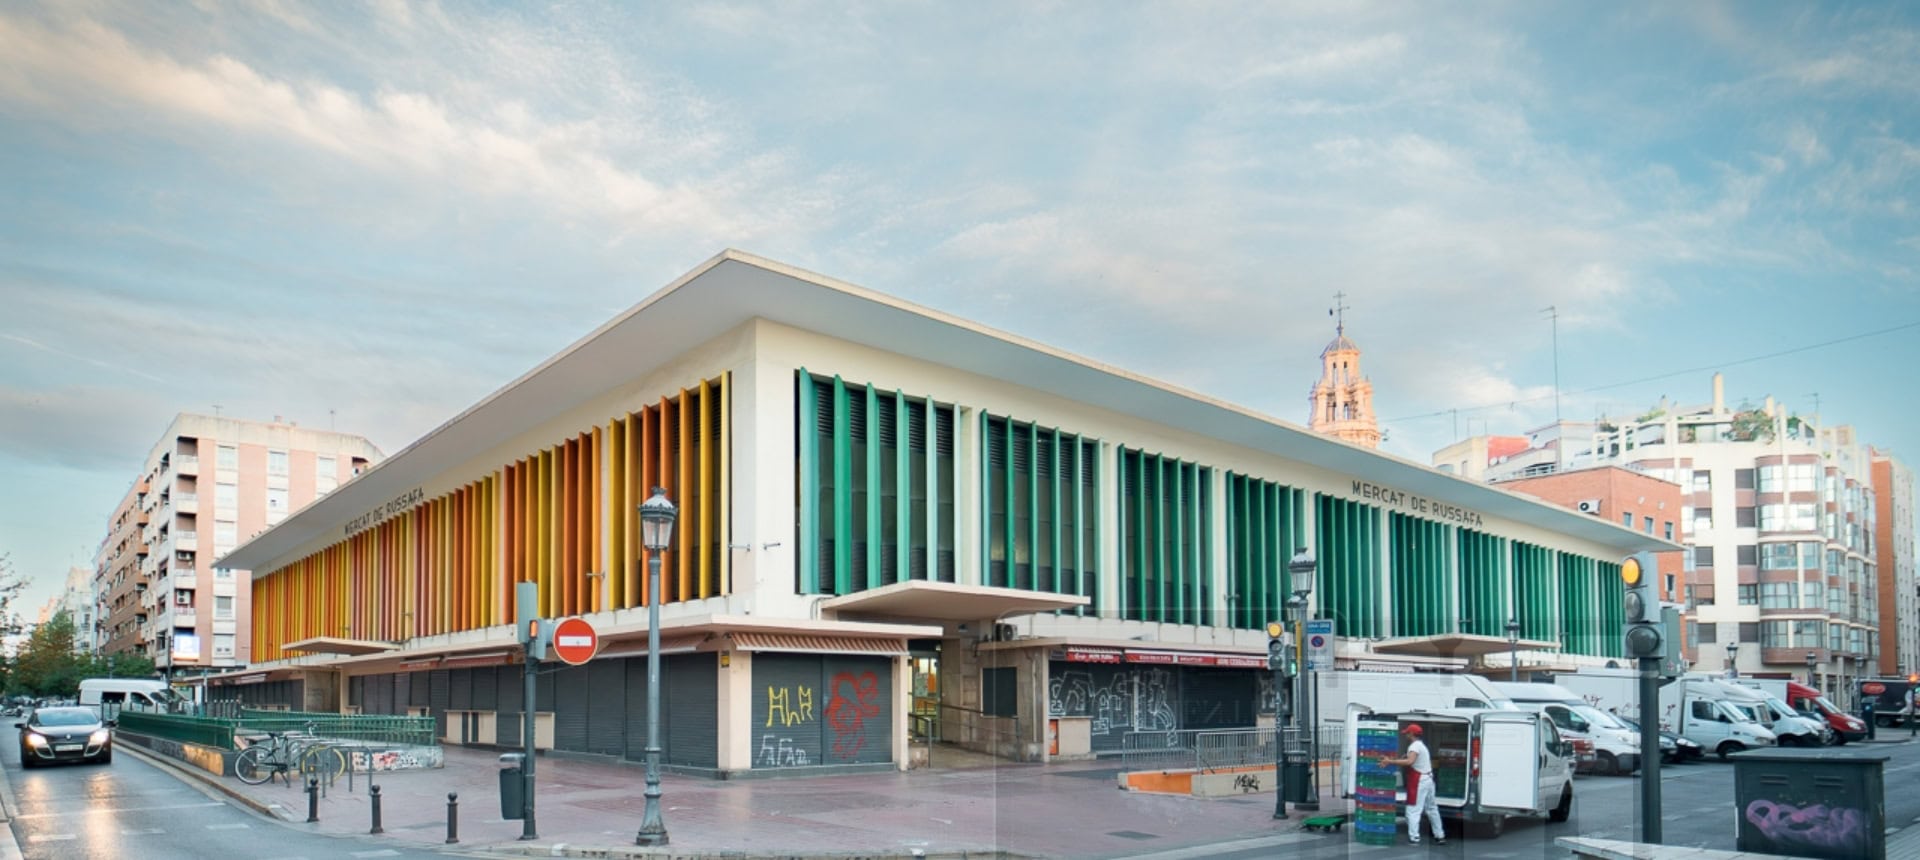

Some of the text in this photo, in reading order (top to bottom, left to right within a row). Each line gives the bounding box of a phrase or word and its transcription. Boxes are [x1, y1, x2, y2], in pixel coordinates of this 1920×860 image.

[344, 487, 424, 535] MERCAT DE RUSSAFA
[1352, 480, 1483, 528] MERCAT DE RUSSAFA
